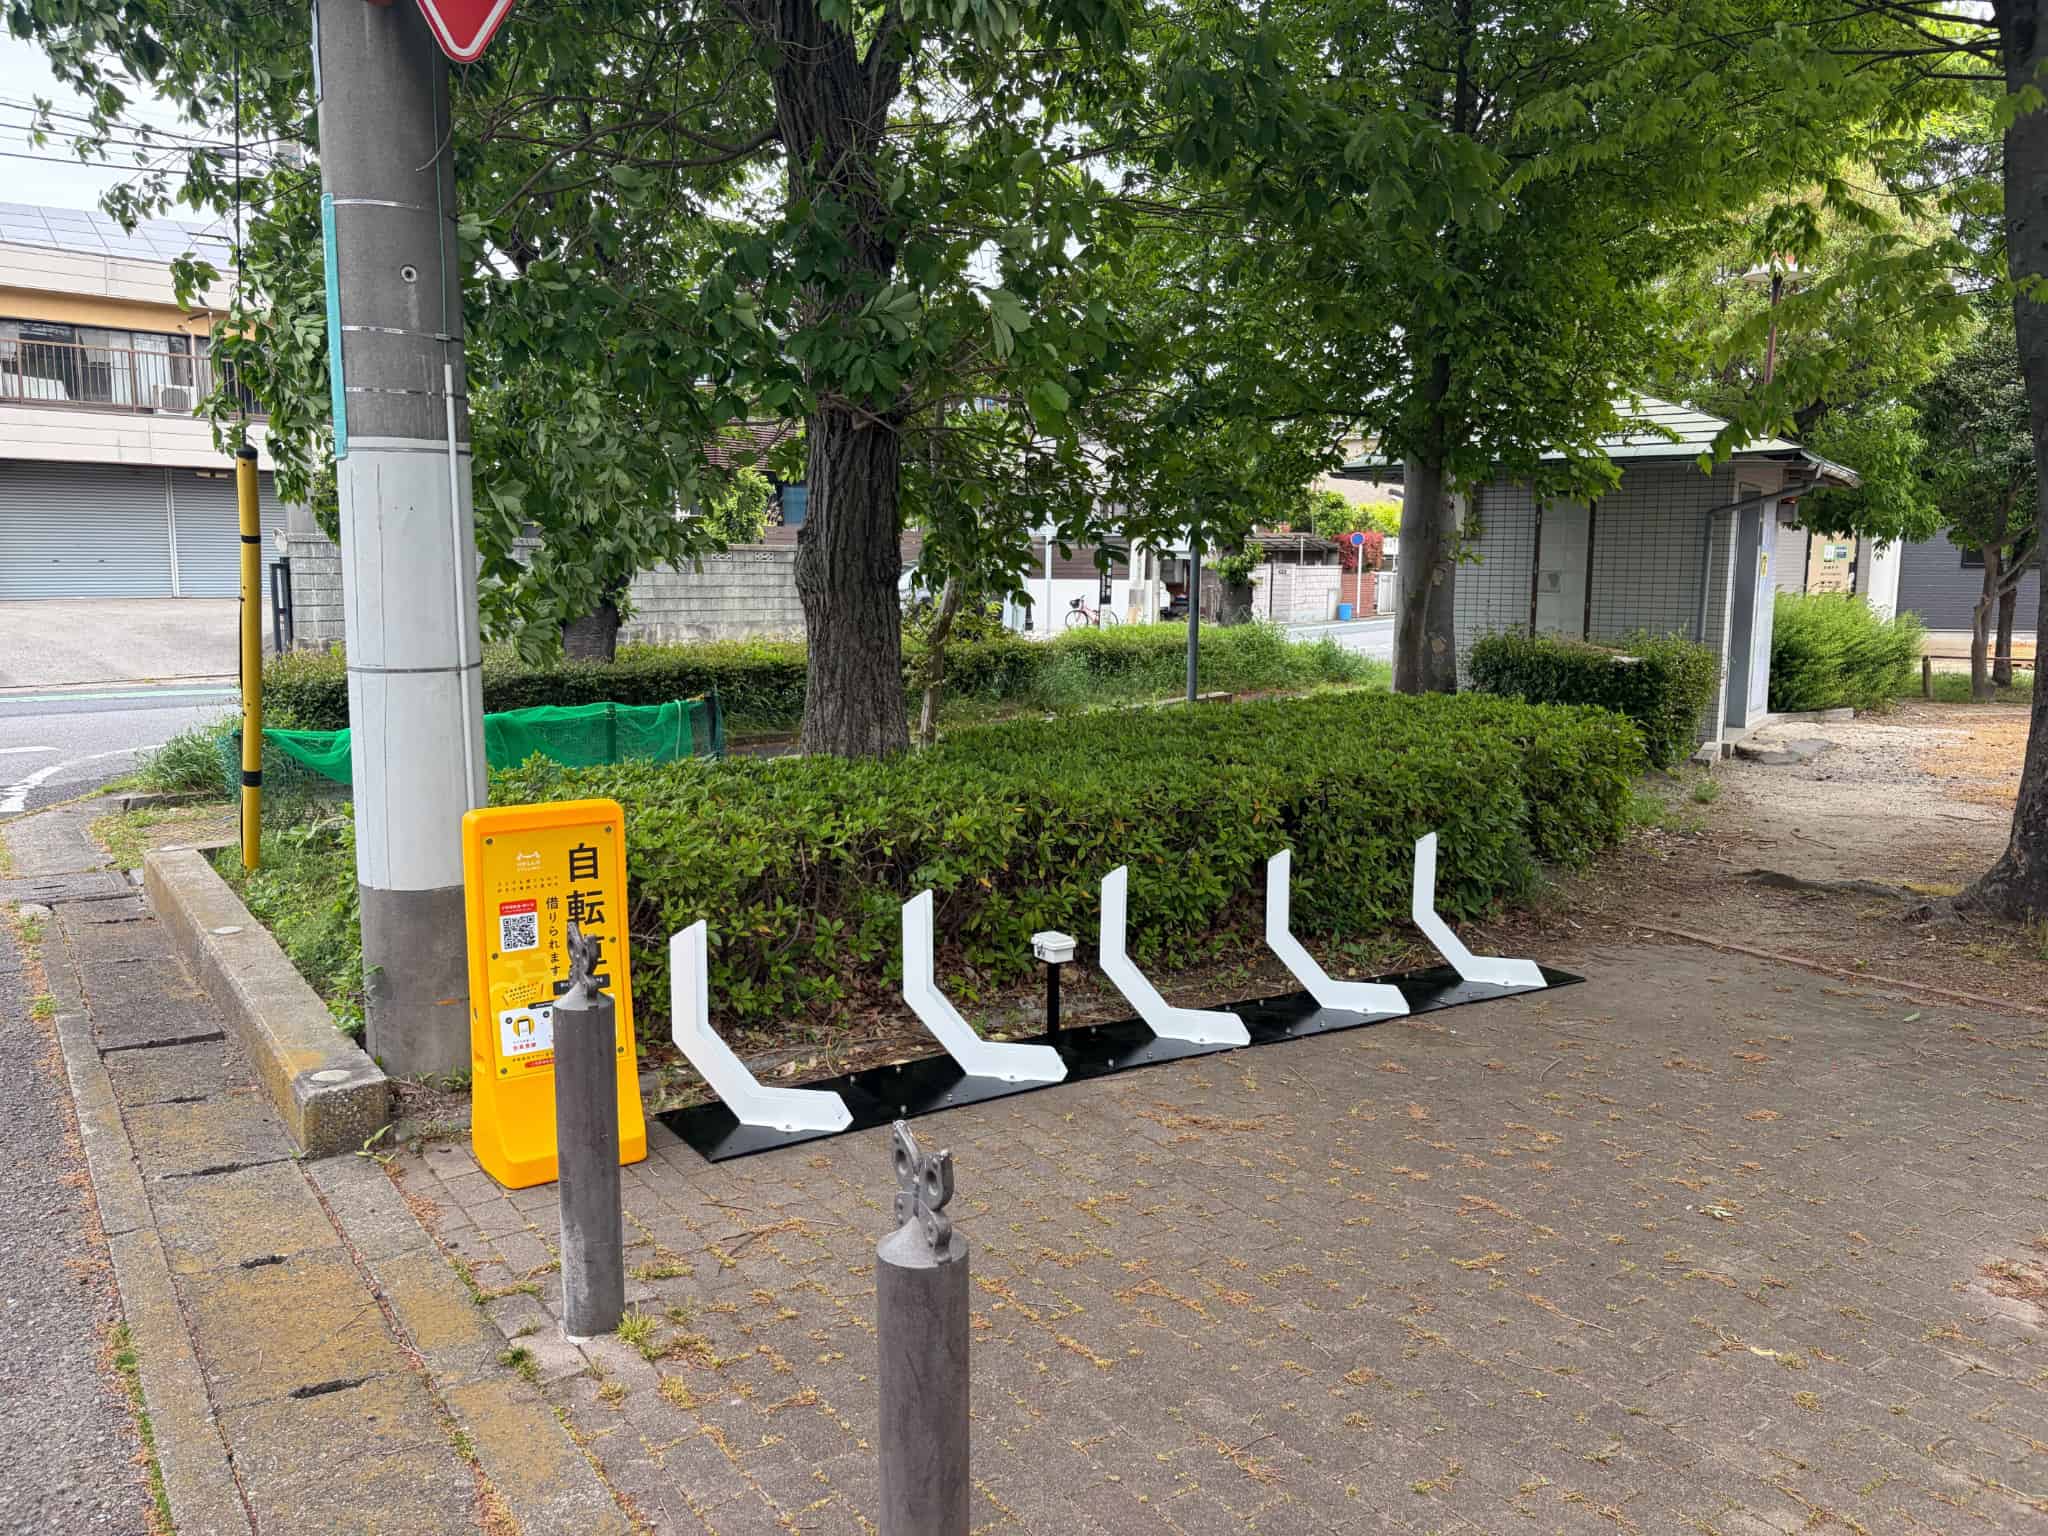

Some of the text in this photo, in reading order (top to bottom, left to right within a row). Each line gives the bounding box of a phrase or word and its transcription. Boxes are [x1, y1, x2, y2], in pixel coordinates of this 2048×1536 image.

[546, 896, 561, 977] 借りられます
